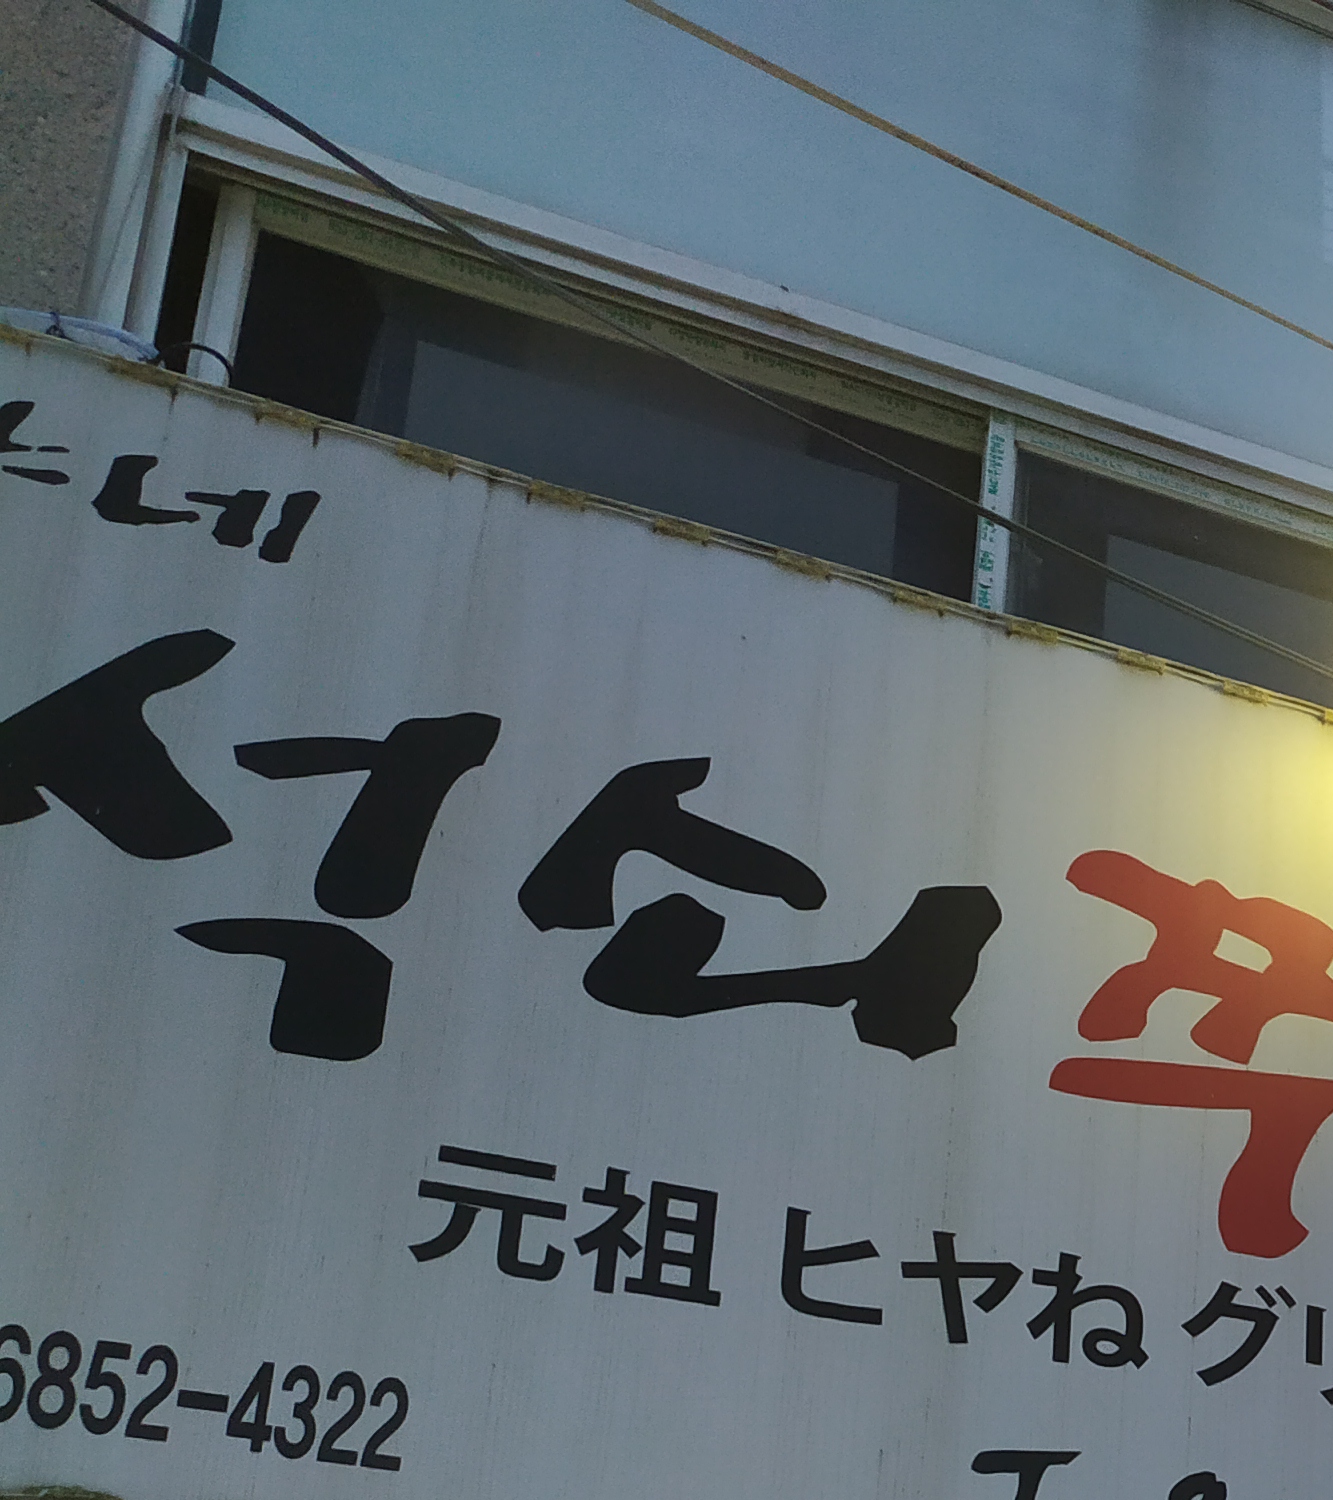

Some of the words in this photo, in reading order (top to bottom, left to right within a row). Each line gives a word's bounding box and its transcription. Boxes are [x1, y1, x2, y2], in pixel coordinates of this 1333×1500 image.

[0, 628, 1003, 1060] 석쇠
[408, 1144, 722, 1308] 元祖
[780, 1208, 1149, 1370] ヒヤね
